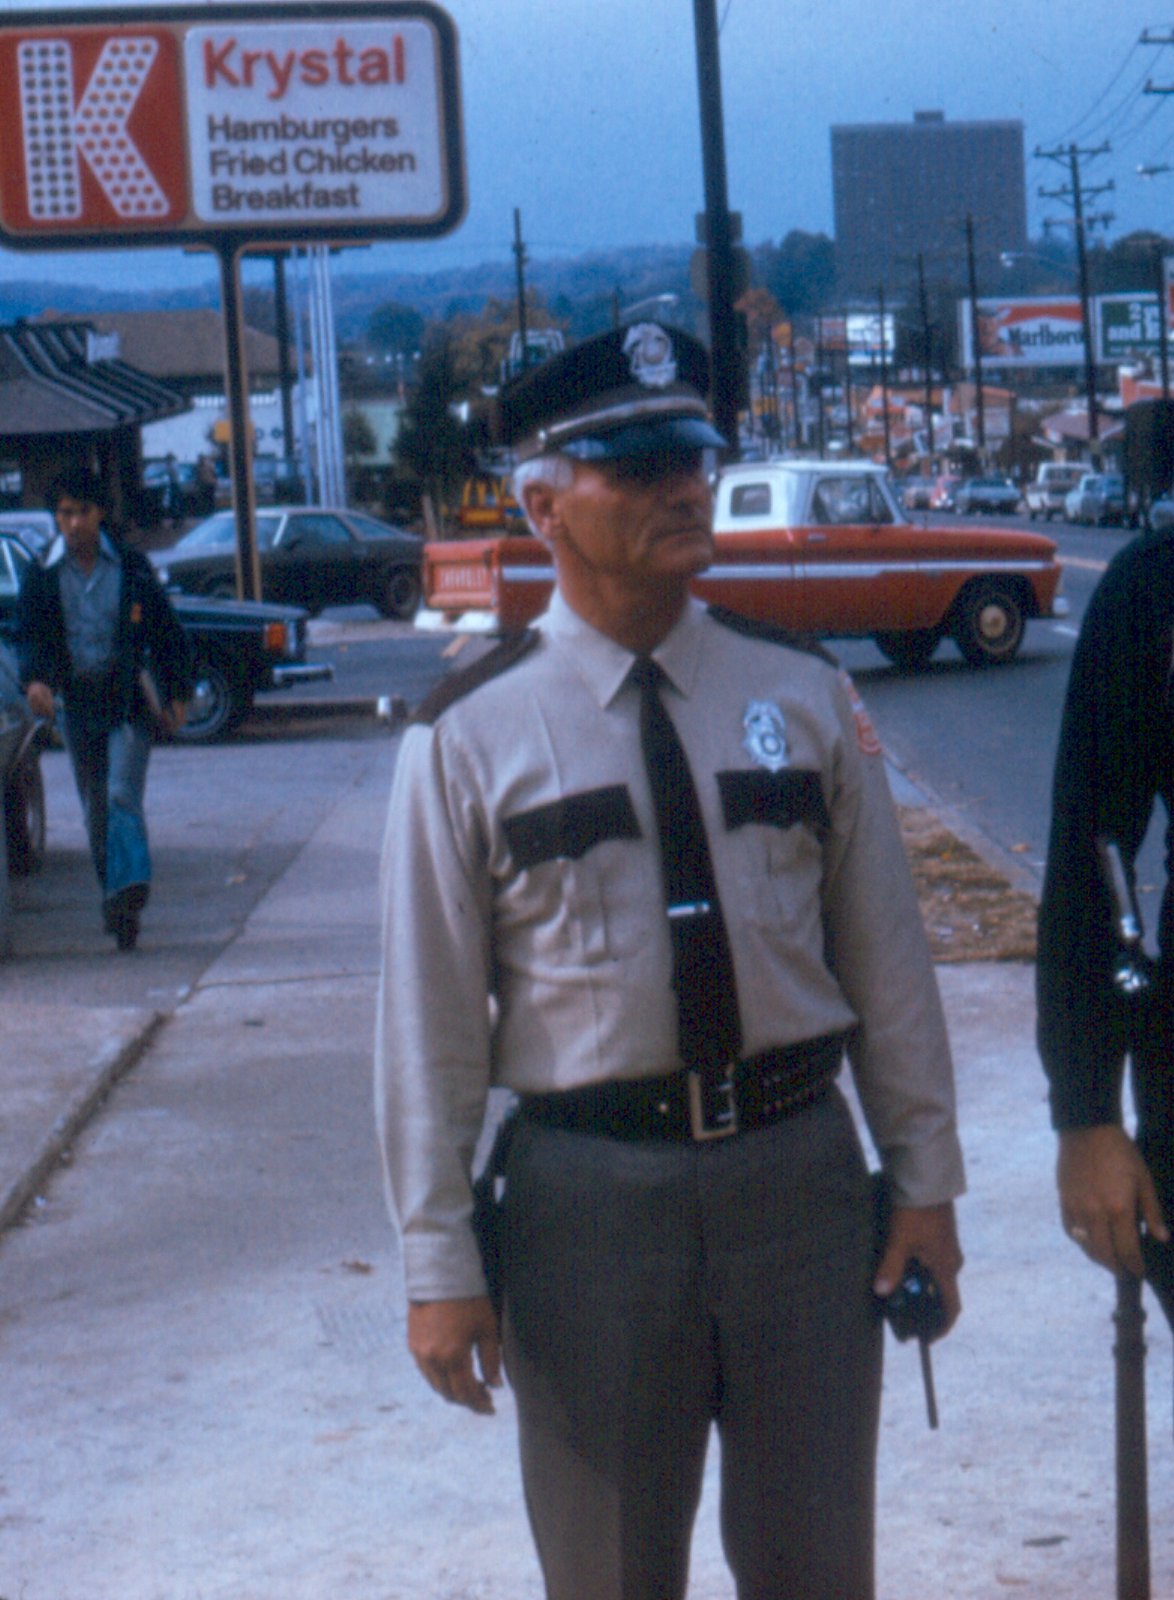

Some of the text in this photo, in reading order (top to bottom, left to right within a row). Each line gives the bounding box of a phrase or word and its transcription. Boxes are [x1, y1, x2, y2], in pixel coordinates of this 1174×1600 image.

[204, 35, 406, 99] Krystal
[207, 114, 400, 143] Hamburgers
[209, 143, 415, 177] Fried Chicken
[211, 180, 360, 212] Breakfast
